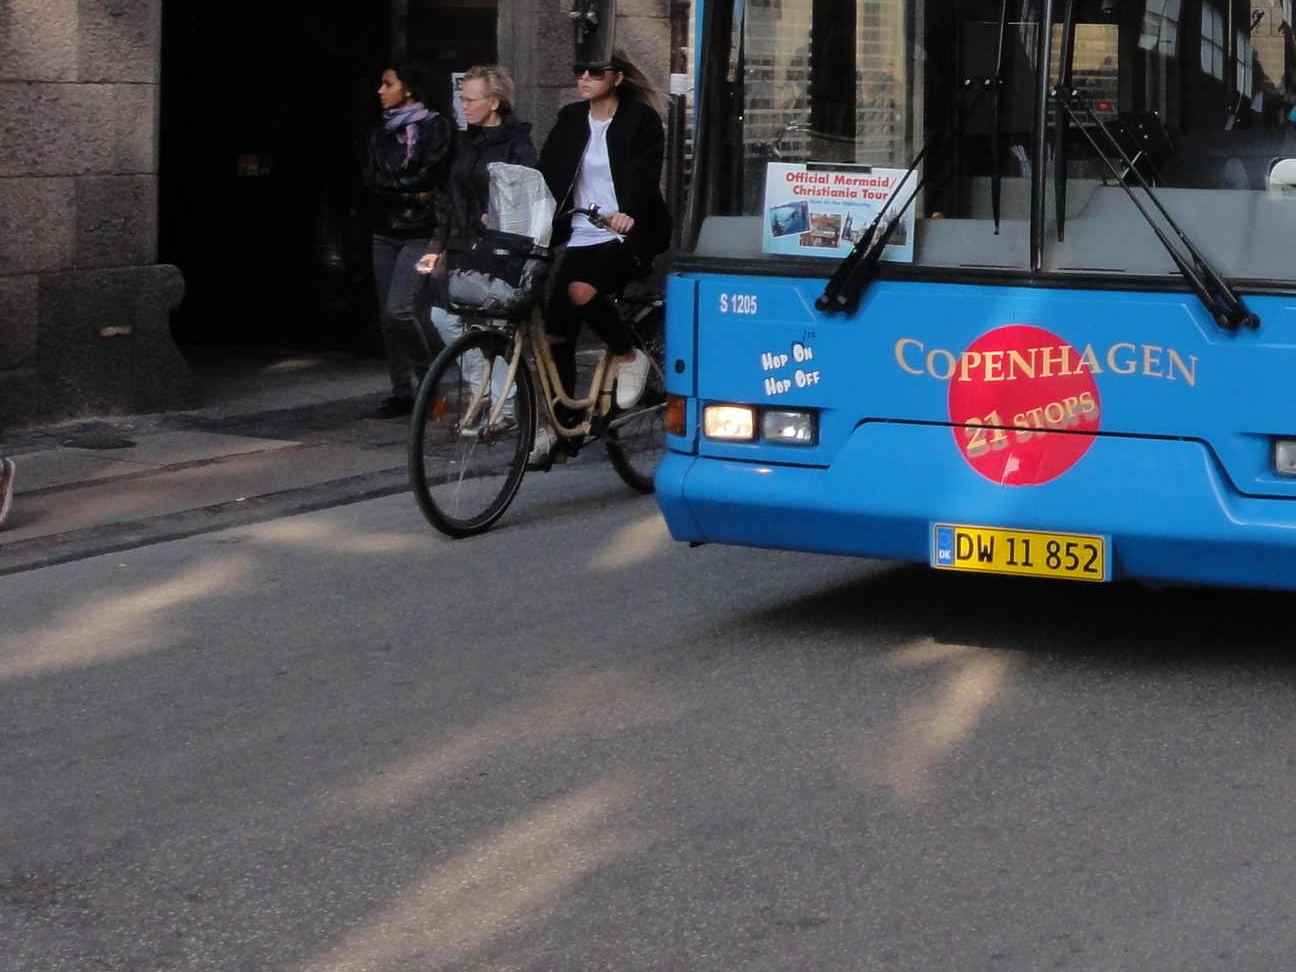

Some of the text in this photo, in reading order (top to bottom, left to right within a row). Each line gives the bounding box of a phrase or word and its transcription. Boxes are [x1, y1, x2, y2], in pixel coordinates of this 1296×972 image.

[785, 172, 898, 189] Official Mermaid/
[792, 185, 888, 200] Christiania Tour
[720, 293, 757, 314] S 1205
[893, 337, 1198, 387] COPENHAGEN
[964, 391, 1096, 453] 21 STOPS
[939, 549, 951, 559] DK
[956, 532, 1099, 573] DW 11 852
